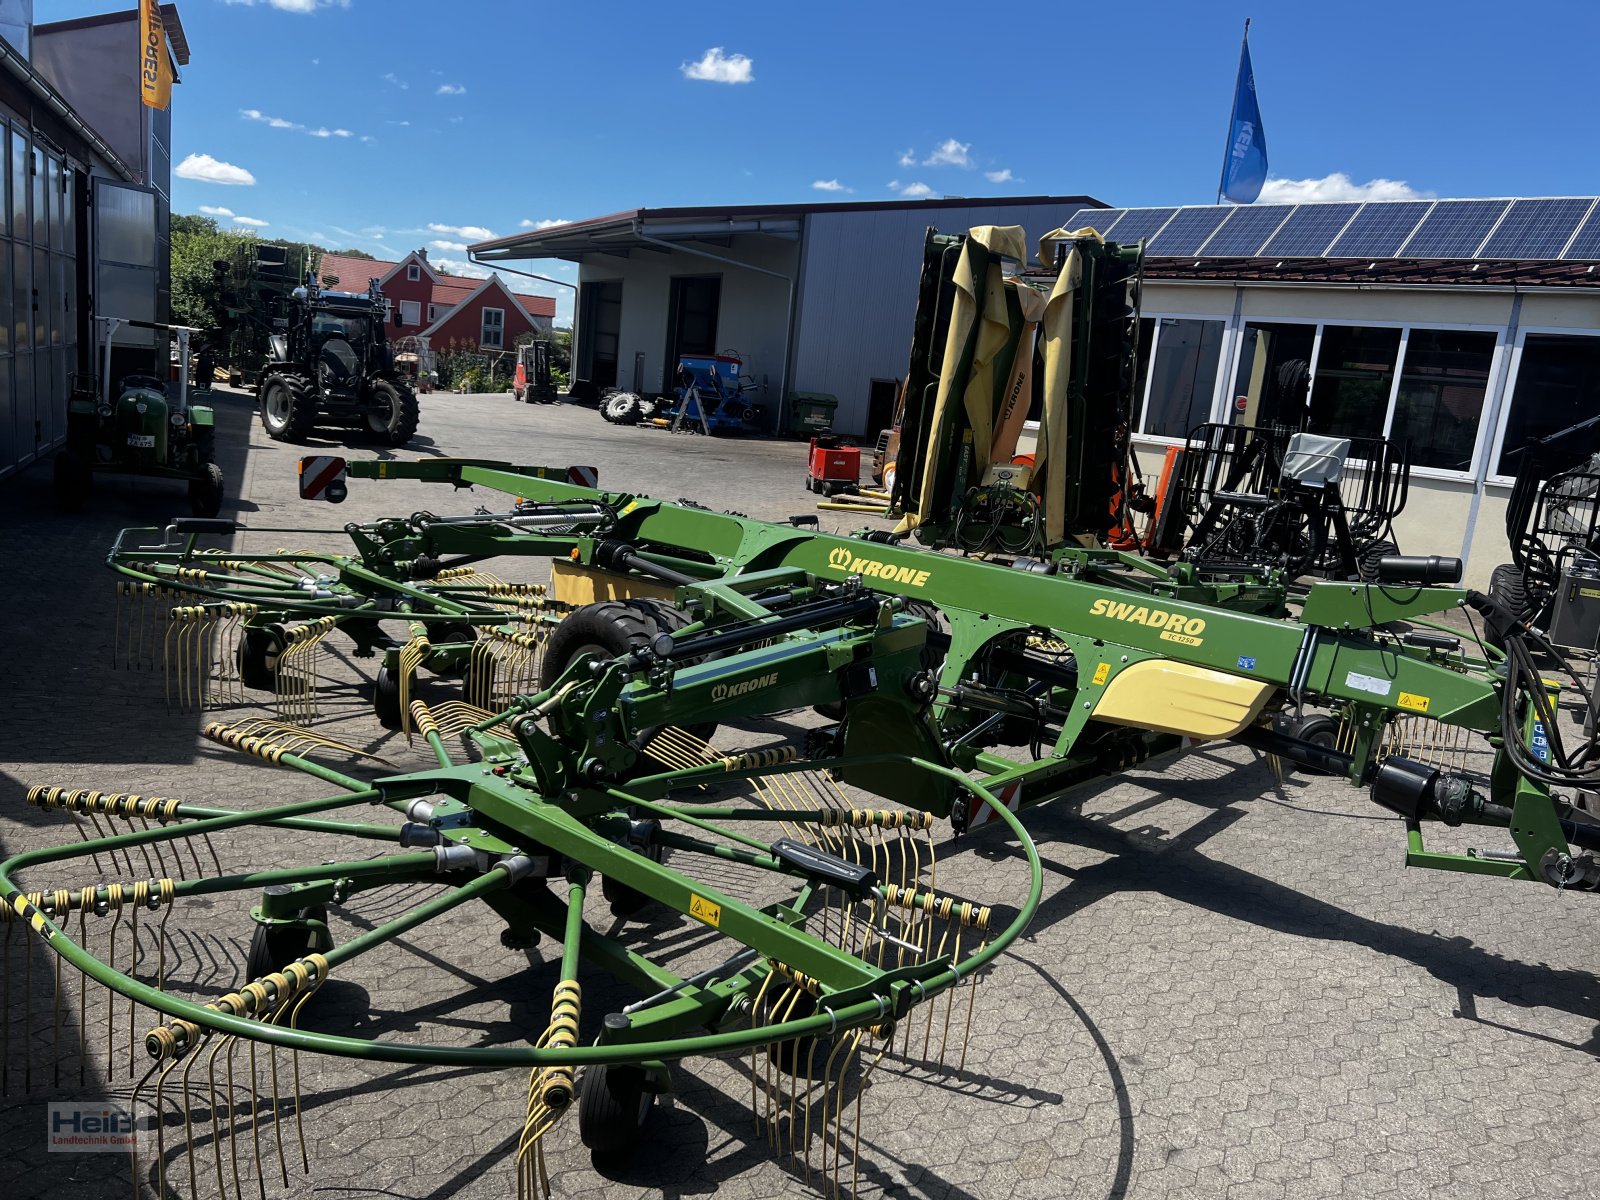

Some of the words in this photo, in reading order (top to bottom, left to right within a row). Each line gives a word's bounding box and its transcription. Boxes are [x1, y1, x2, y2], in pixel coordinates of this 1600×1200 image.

[1009, 371, 1026, 410] KRONE
[849, 558, 932, 587] KRONE
[1089, 599, 1206, 636] SWADRO
[1168, 633, 1177, 641] TC
[1178, 635, 1195, 645] 1250
[727, 672, 779, 698] KRONE
